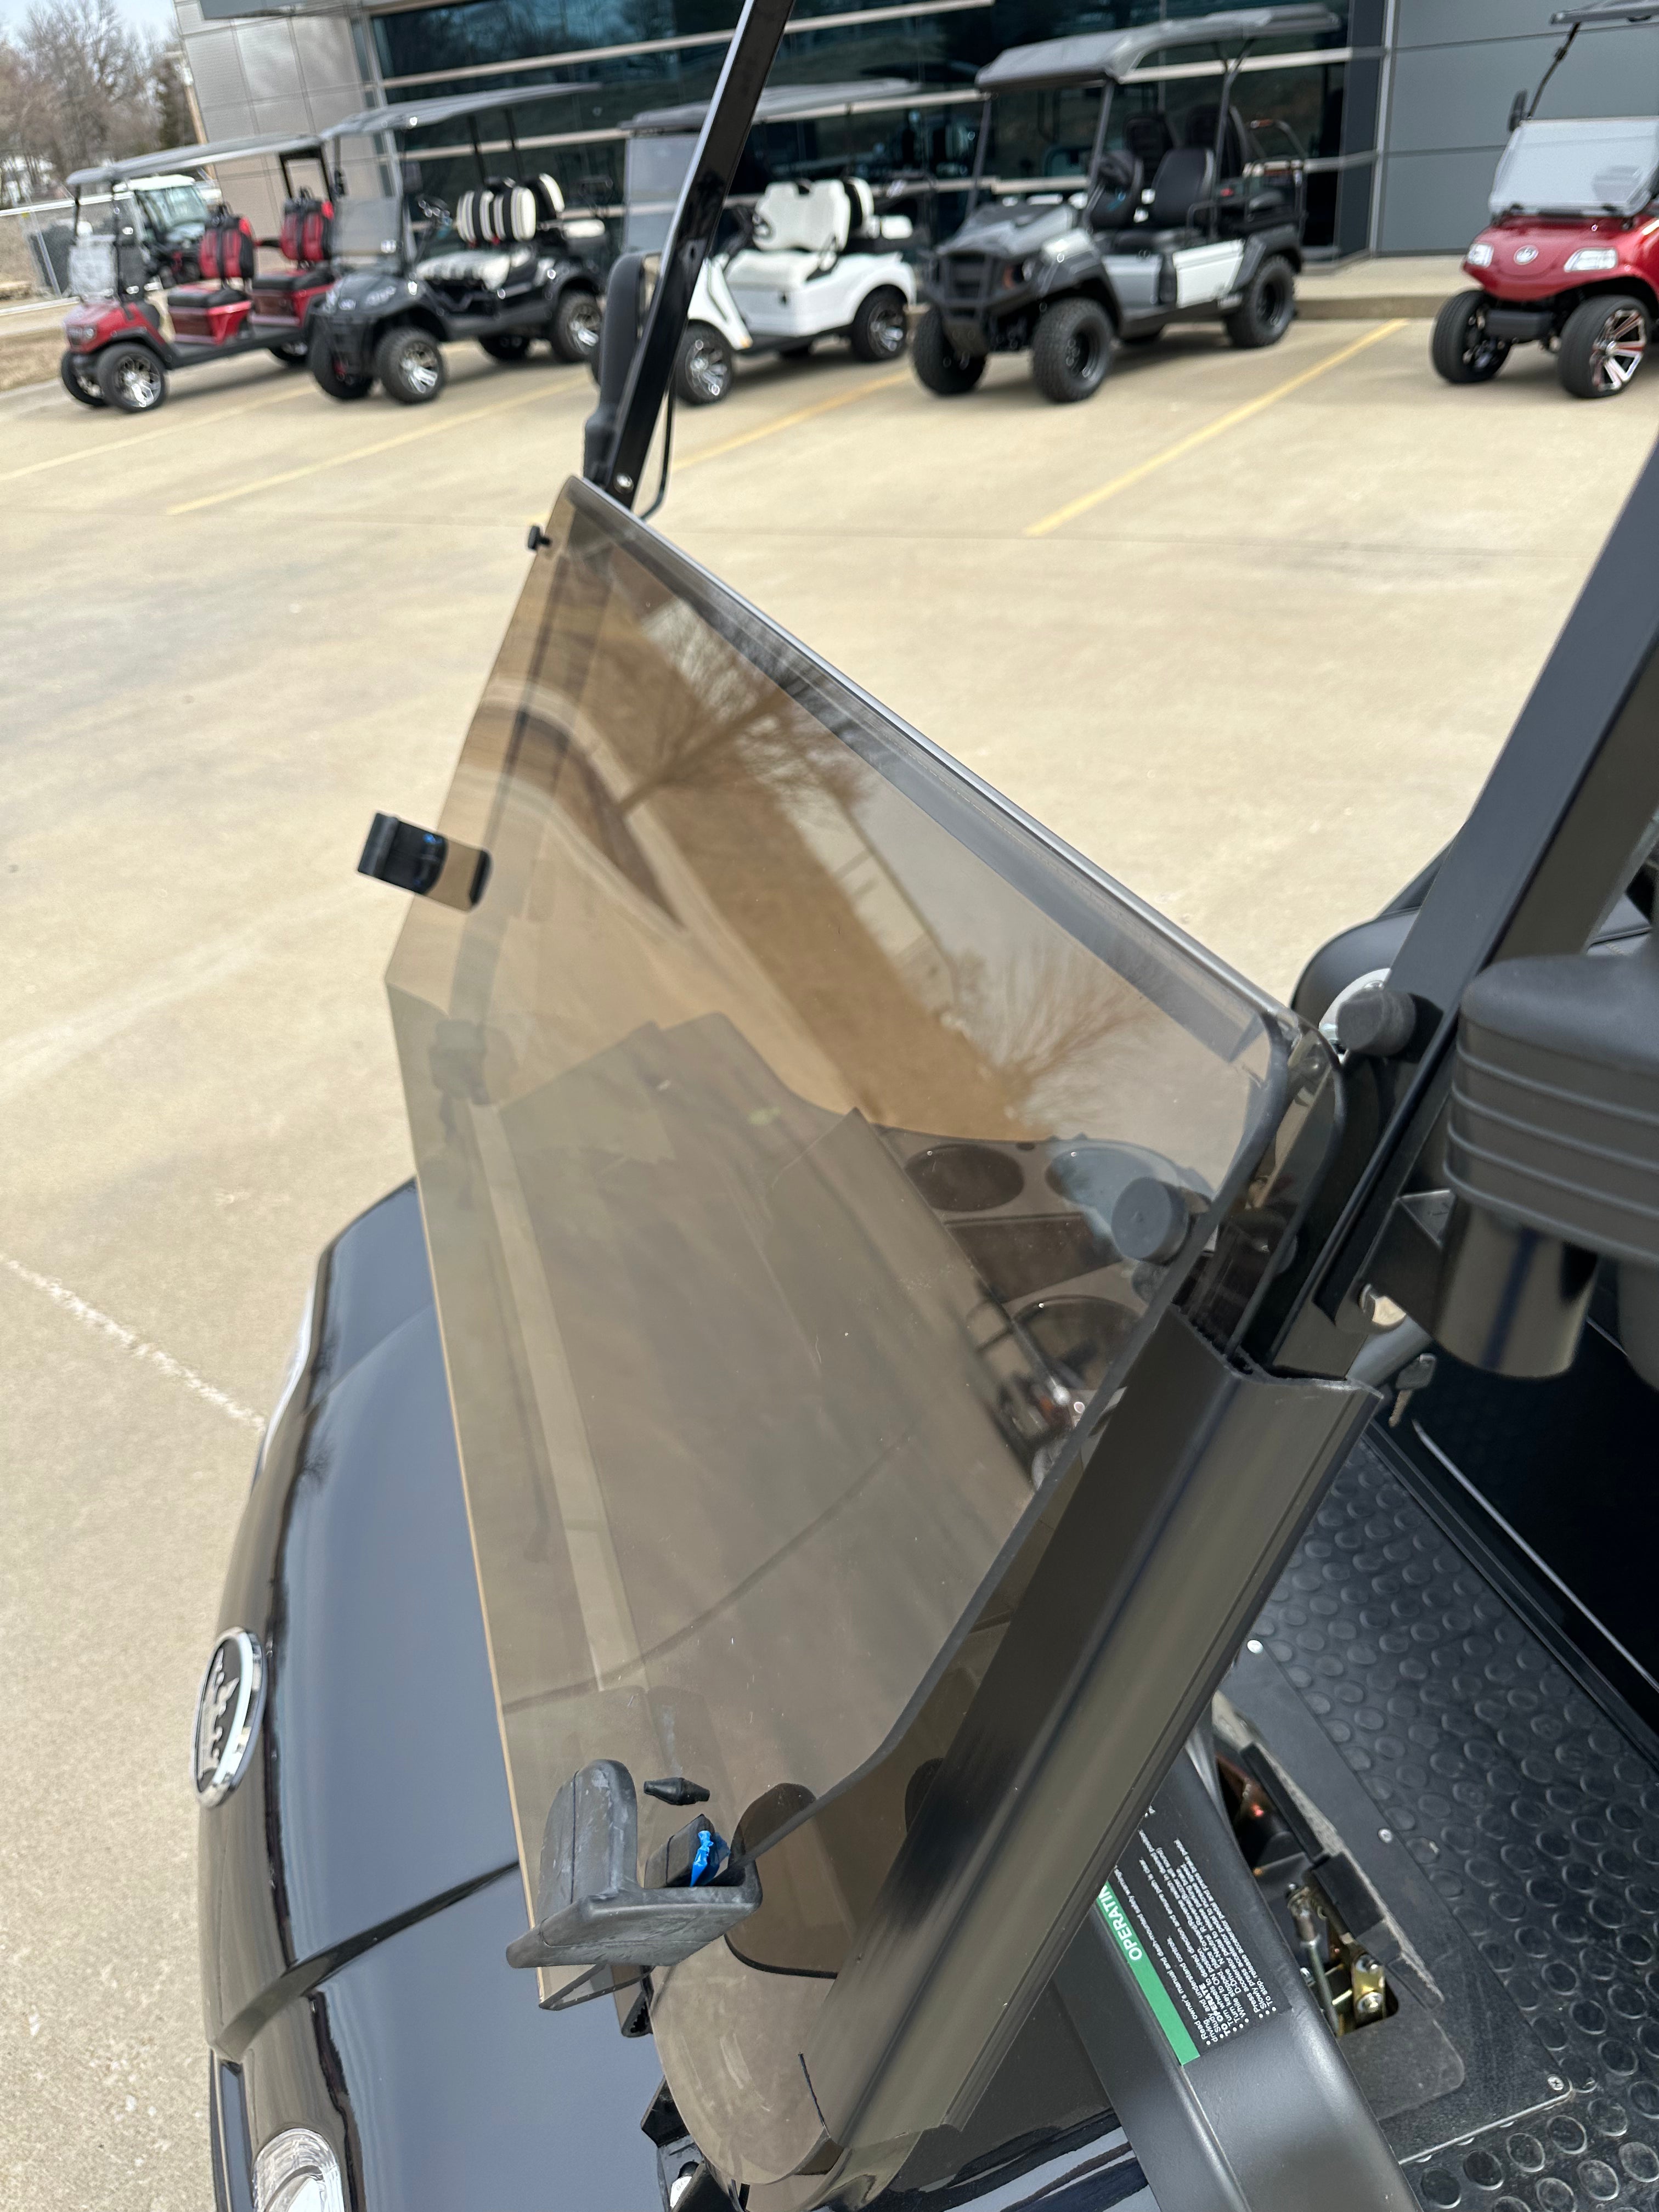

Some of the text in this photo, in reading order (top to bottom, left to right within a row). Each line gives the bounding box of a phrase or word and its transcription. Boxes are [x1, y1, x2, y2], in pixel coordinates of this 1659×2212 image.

[1159, 1956, 1171, 1970] and
[1241, 1954, 1258, 1979] release
[1166, 1969, 1184, 1994] manual
[1178, 1962, 1203, 1999] understand
[1205, 1977, 1212, 1986] to
[1209, 1972, 1221, 1985] ON
[1216, 1968, 1236, 1997] stopped,
[1224, 1968, 1242, 1995] D-Drive
[1225, 1956, 1250, 1993] accelerator
[1240, 1967, 1256, 1987] press
[1217, 1985, 1225, 1994] to
[1254, 1978, 1268, 1995] stop,
[1181, 1994, 1198, 2020] owner's
[1198, 1998, 1211, 2012] and
[1209, 1985, 1225, 2010] wheels
[1221, 1993, 1232, 2007] key
[1232, 1997, 1246, 2018] While
[1246, 1992, 1261, 2013] Press
[1251, 1987, 1267, 2010] Slowly
[1265, 1995, 1273, 2007] To
[1198, 1982, 1231, 2037] TO OPERATE
[1222, 2008, 1234, 2027] Turn
[1228, 2005, 1240, 2024] Turn
[1193, 2019, 1209, 2040] Read
[1203, 2017, 1218, 2042] driving.
[1206, 2012, 1221, 2033] Study
